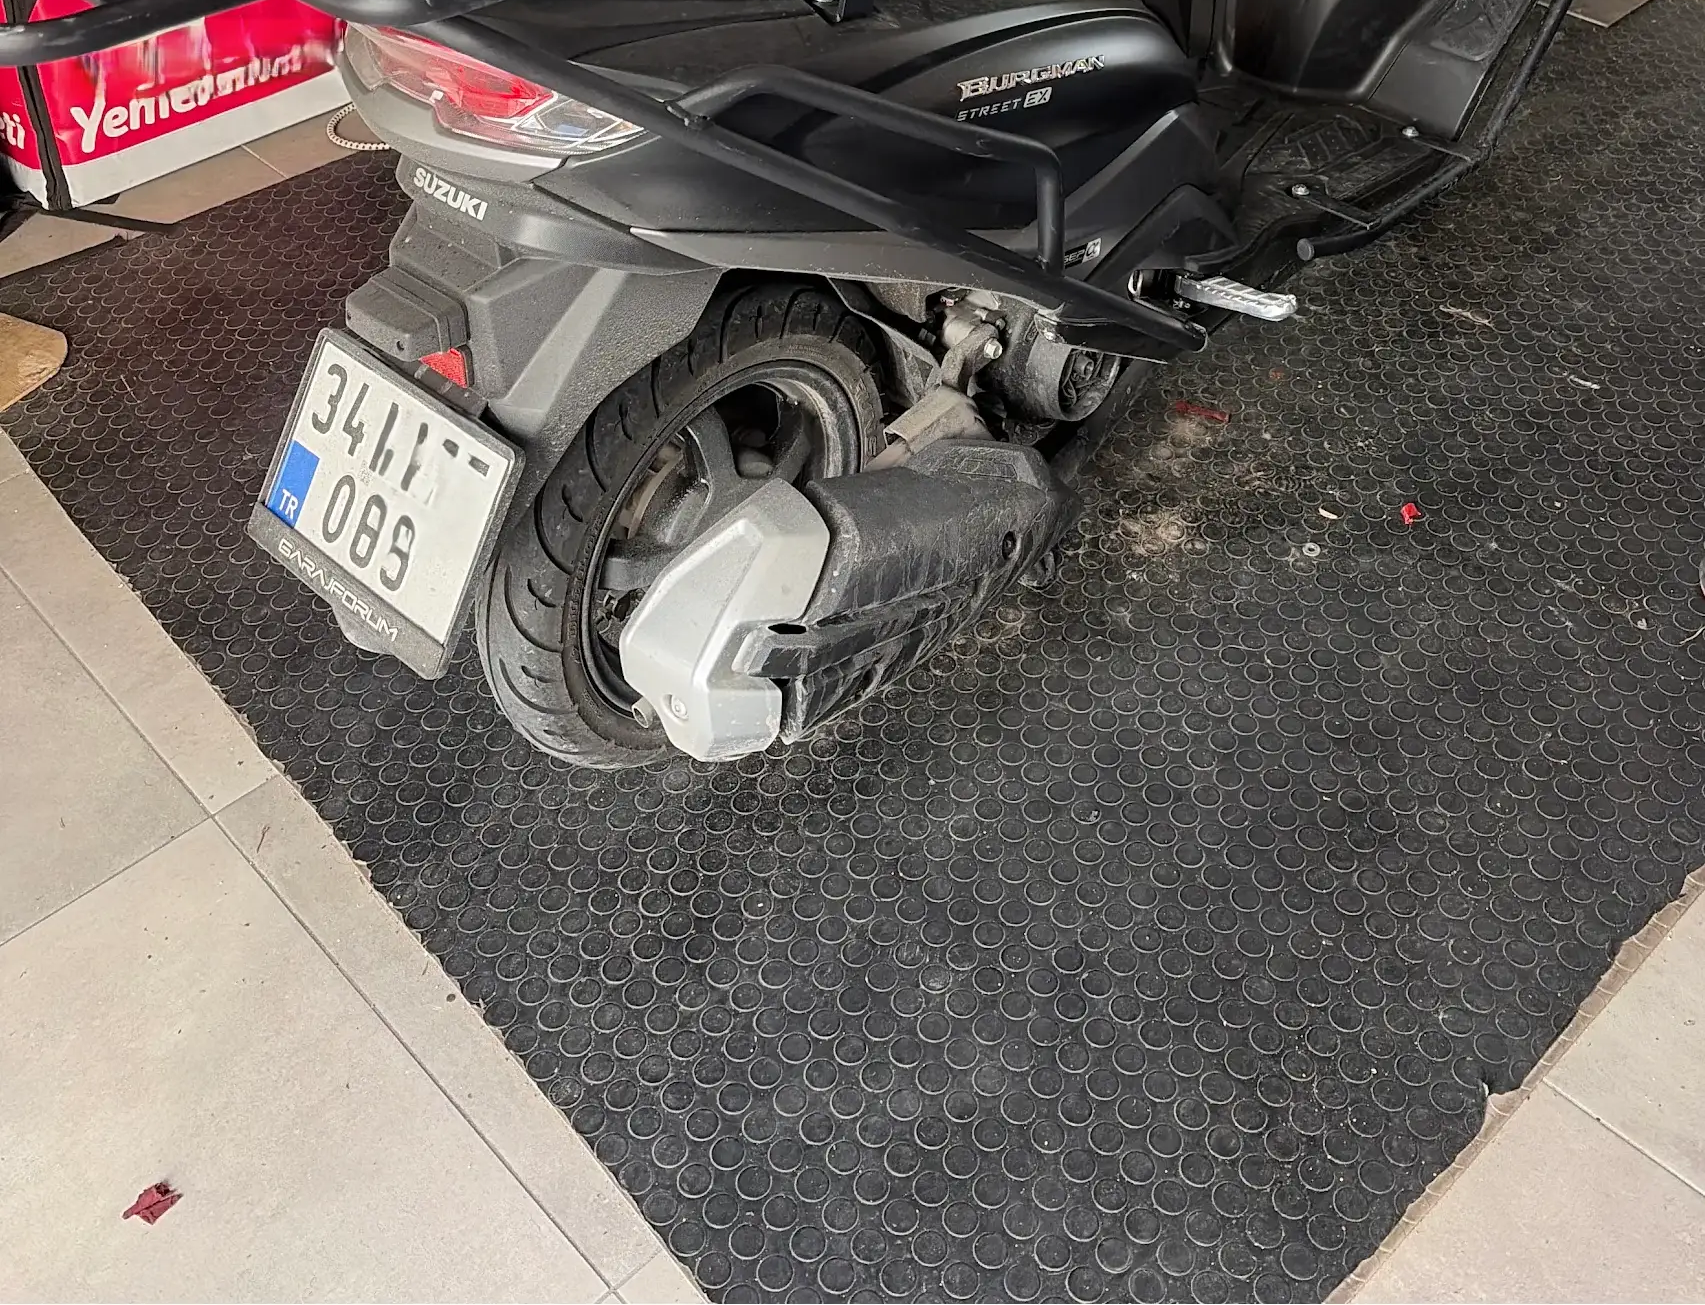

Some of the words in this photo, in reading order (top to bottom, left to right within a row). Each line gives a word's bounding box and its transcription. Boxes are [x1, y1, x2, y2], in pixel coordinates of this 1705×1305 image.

[956, 55, 1105, 102] BURGMAN
[956, 98, 1022, 122] STREET
[1025, 87, 1052, 108] EX
[413, 167, 488, 221] SUZUKI
[279, 489, 299, 520] TR
[277, 537, 400, 642] GARAJFORUM
